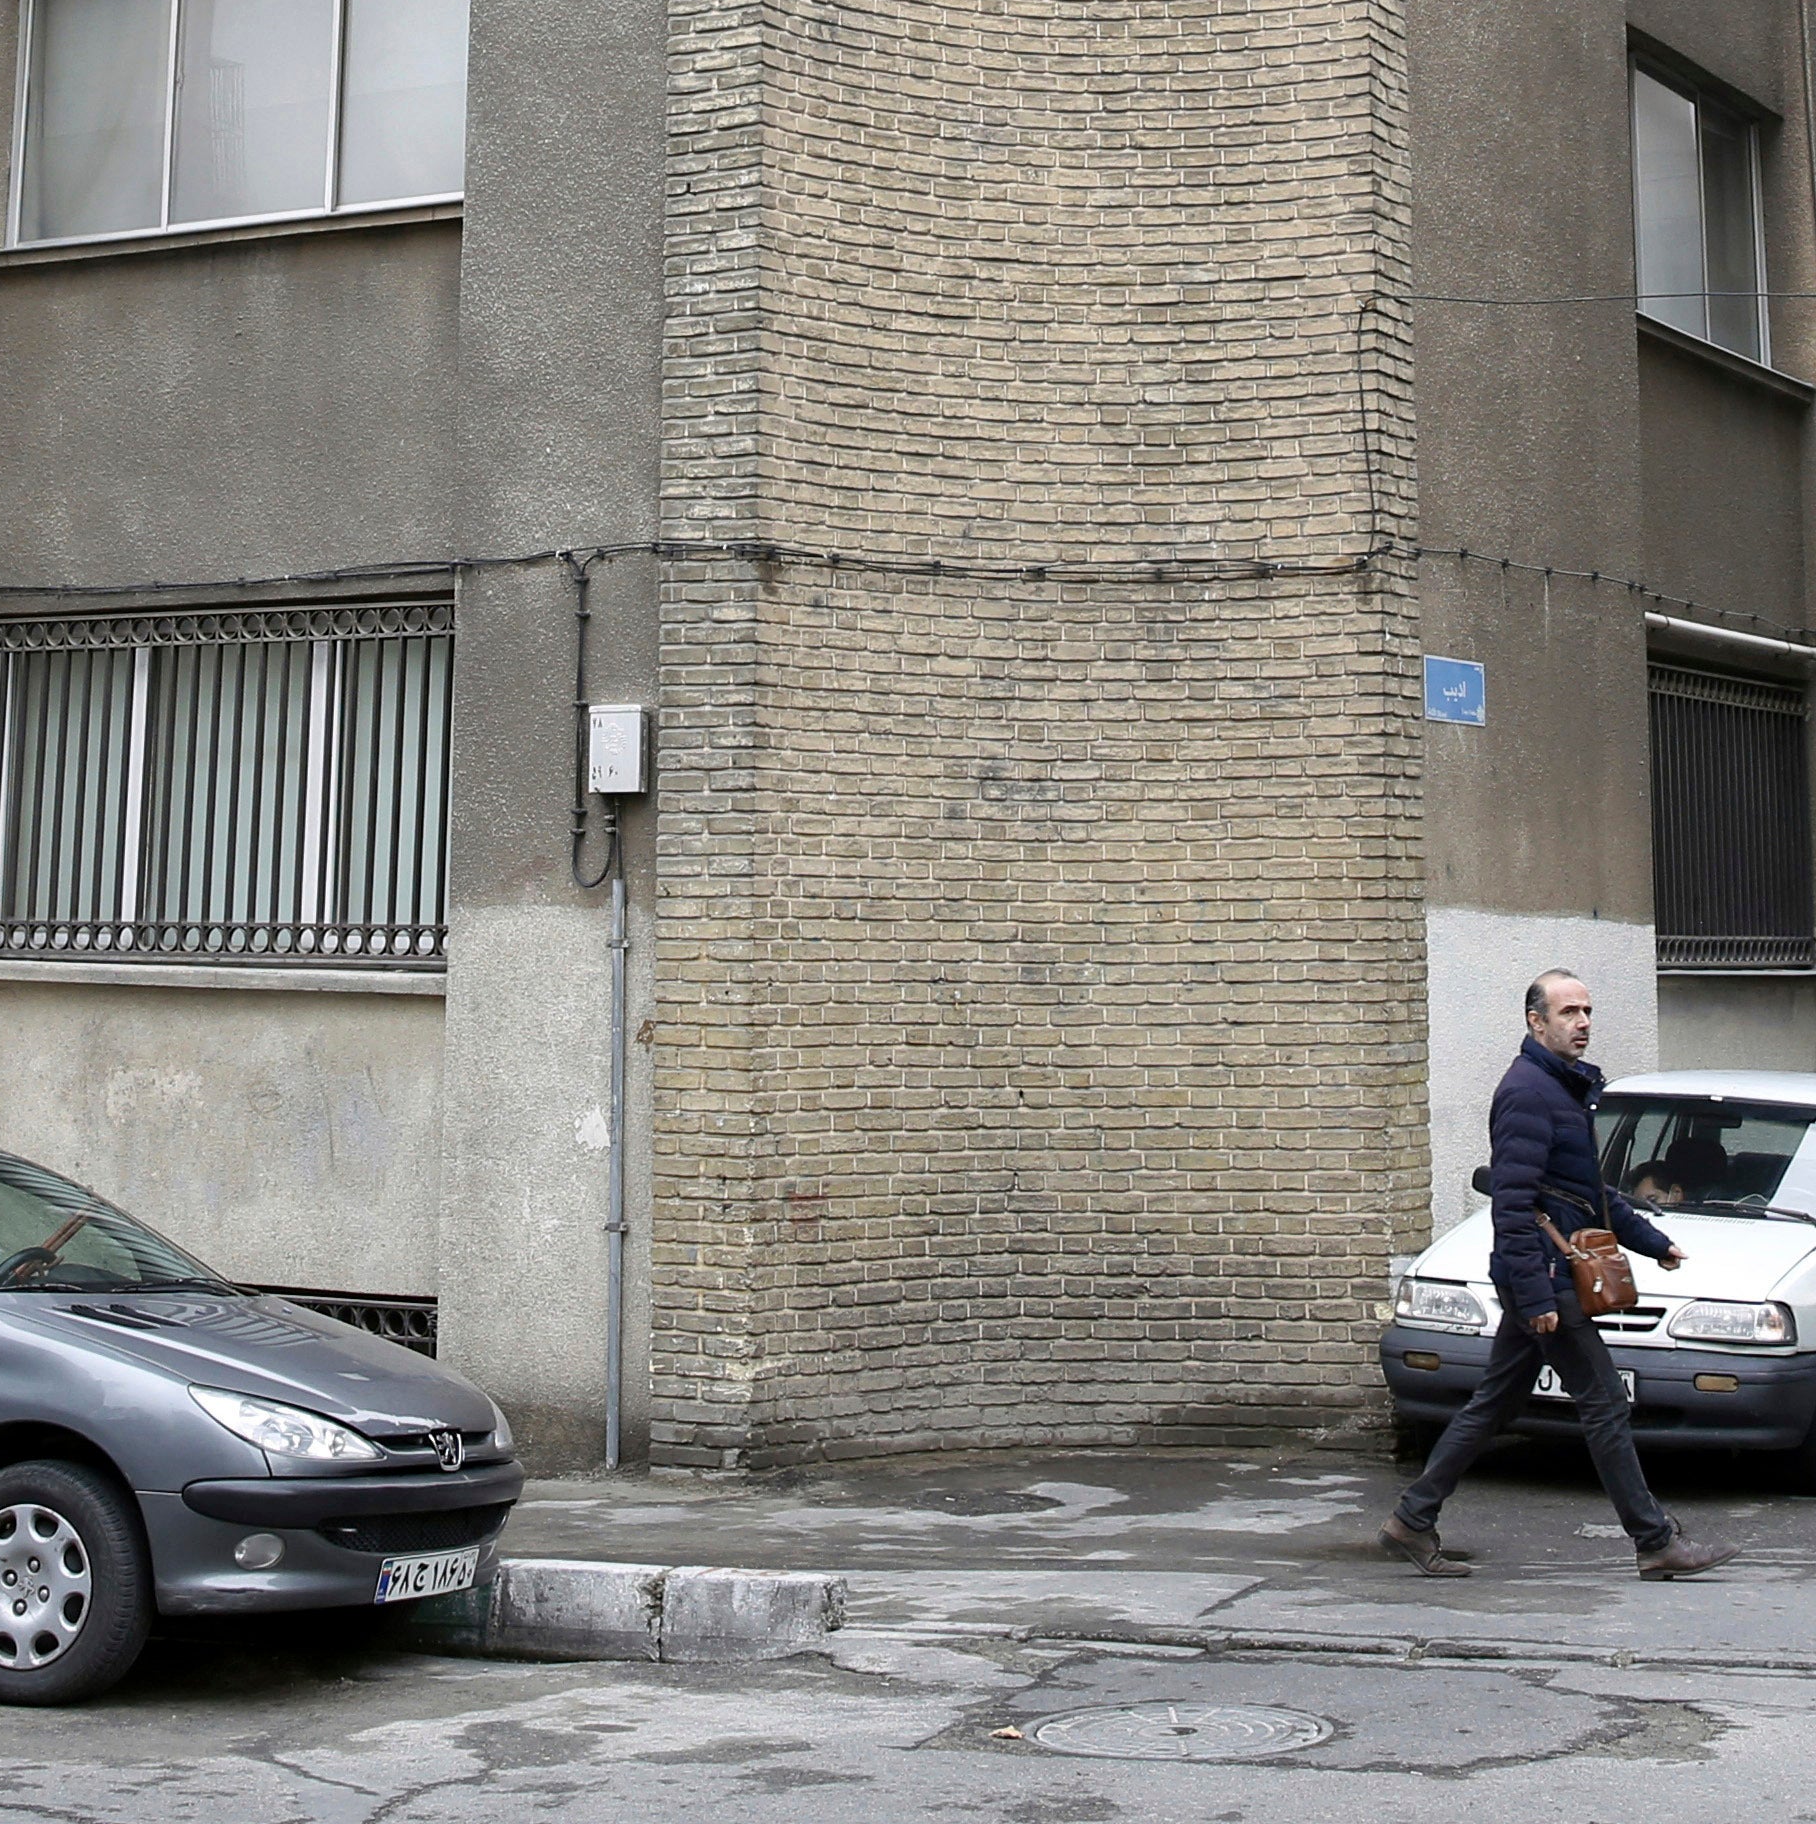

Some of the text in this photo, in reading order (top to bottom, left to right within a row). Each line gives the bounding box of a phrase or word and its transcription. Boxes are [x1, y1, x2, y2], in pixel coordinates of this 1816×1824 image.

[1442, 680, 1467, 702] ادیب
[388, 1563, 411, 1596] ۶۸
[413, 1561, 430, 1592] ج
[431, 1557, 460, 1591] ۱۸۶
